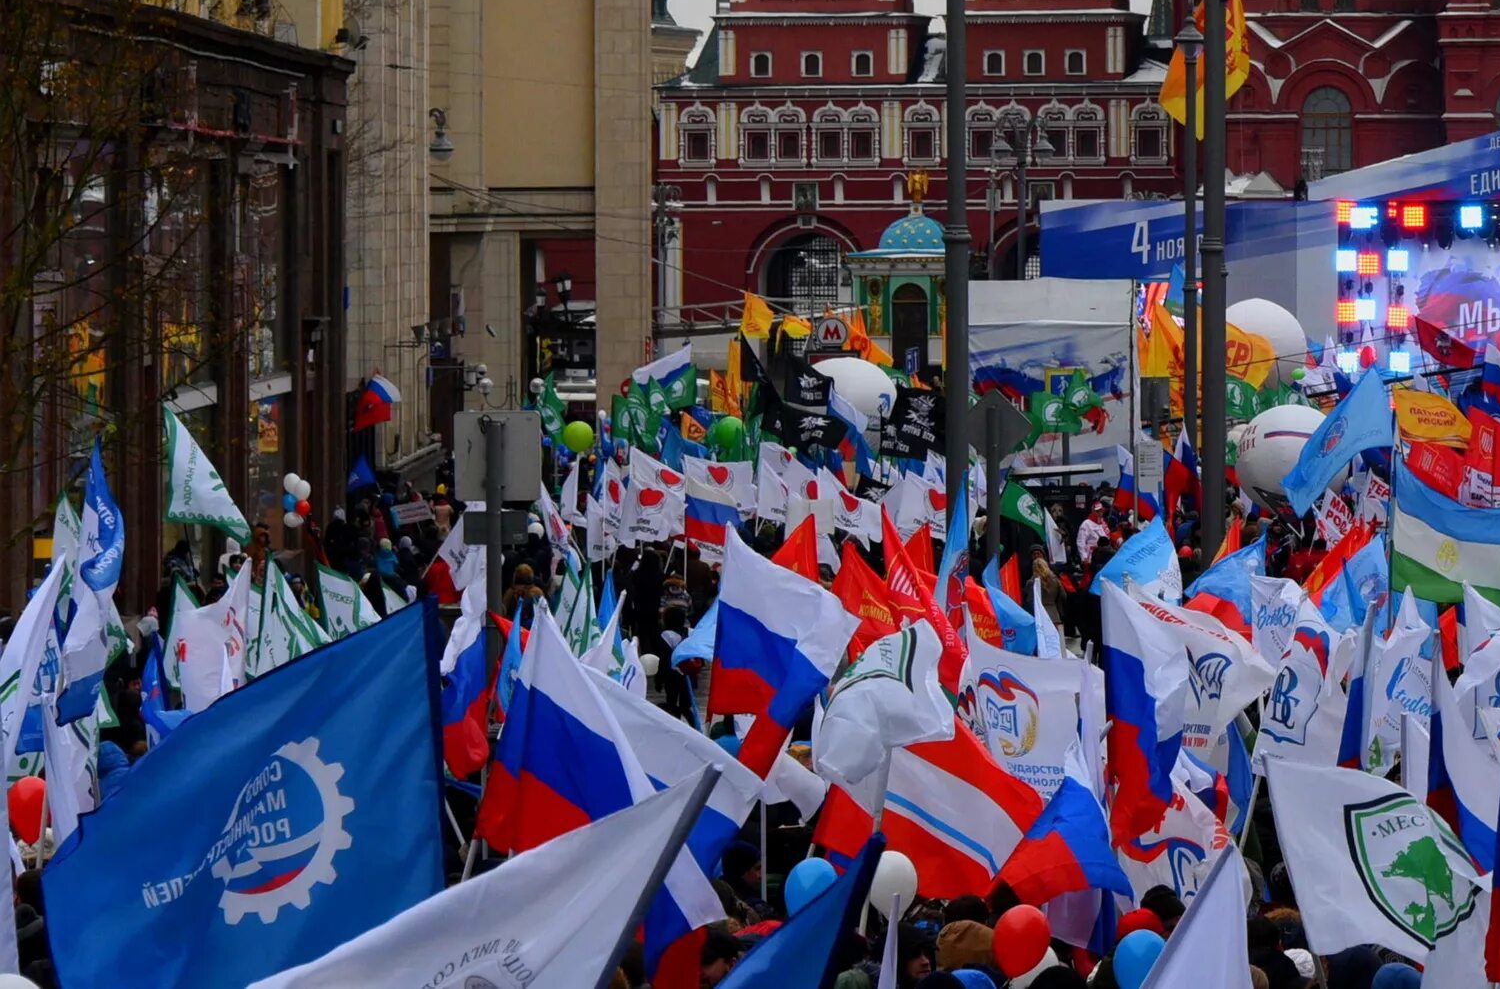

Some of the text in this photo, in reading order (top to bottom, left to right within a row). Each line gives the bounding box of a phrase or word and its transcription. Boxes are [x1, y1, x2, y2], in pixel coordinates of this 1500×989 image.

[1131, 220, 1152, 266] 4
[823, 324, 841, 341] М
[1007, 761, 1065, 780] ударстве
